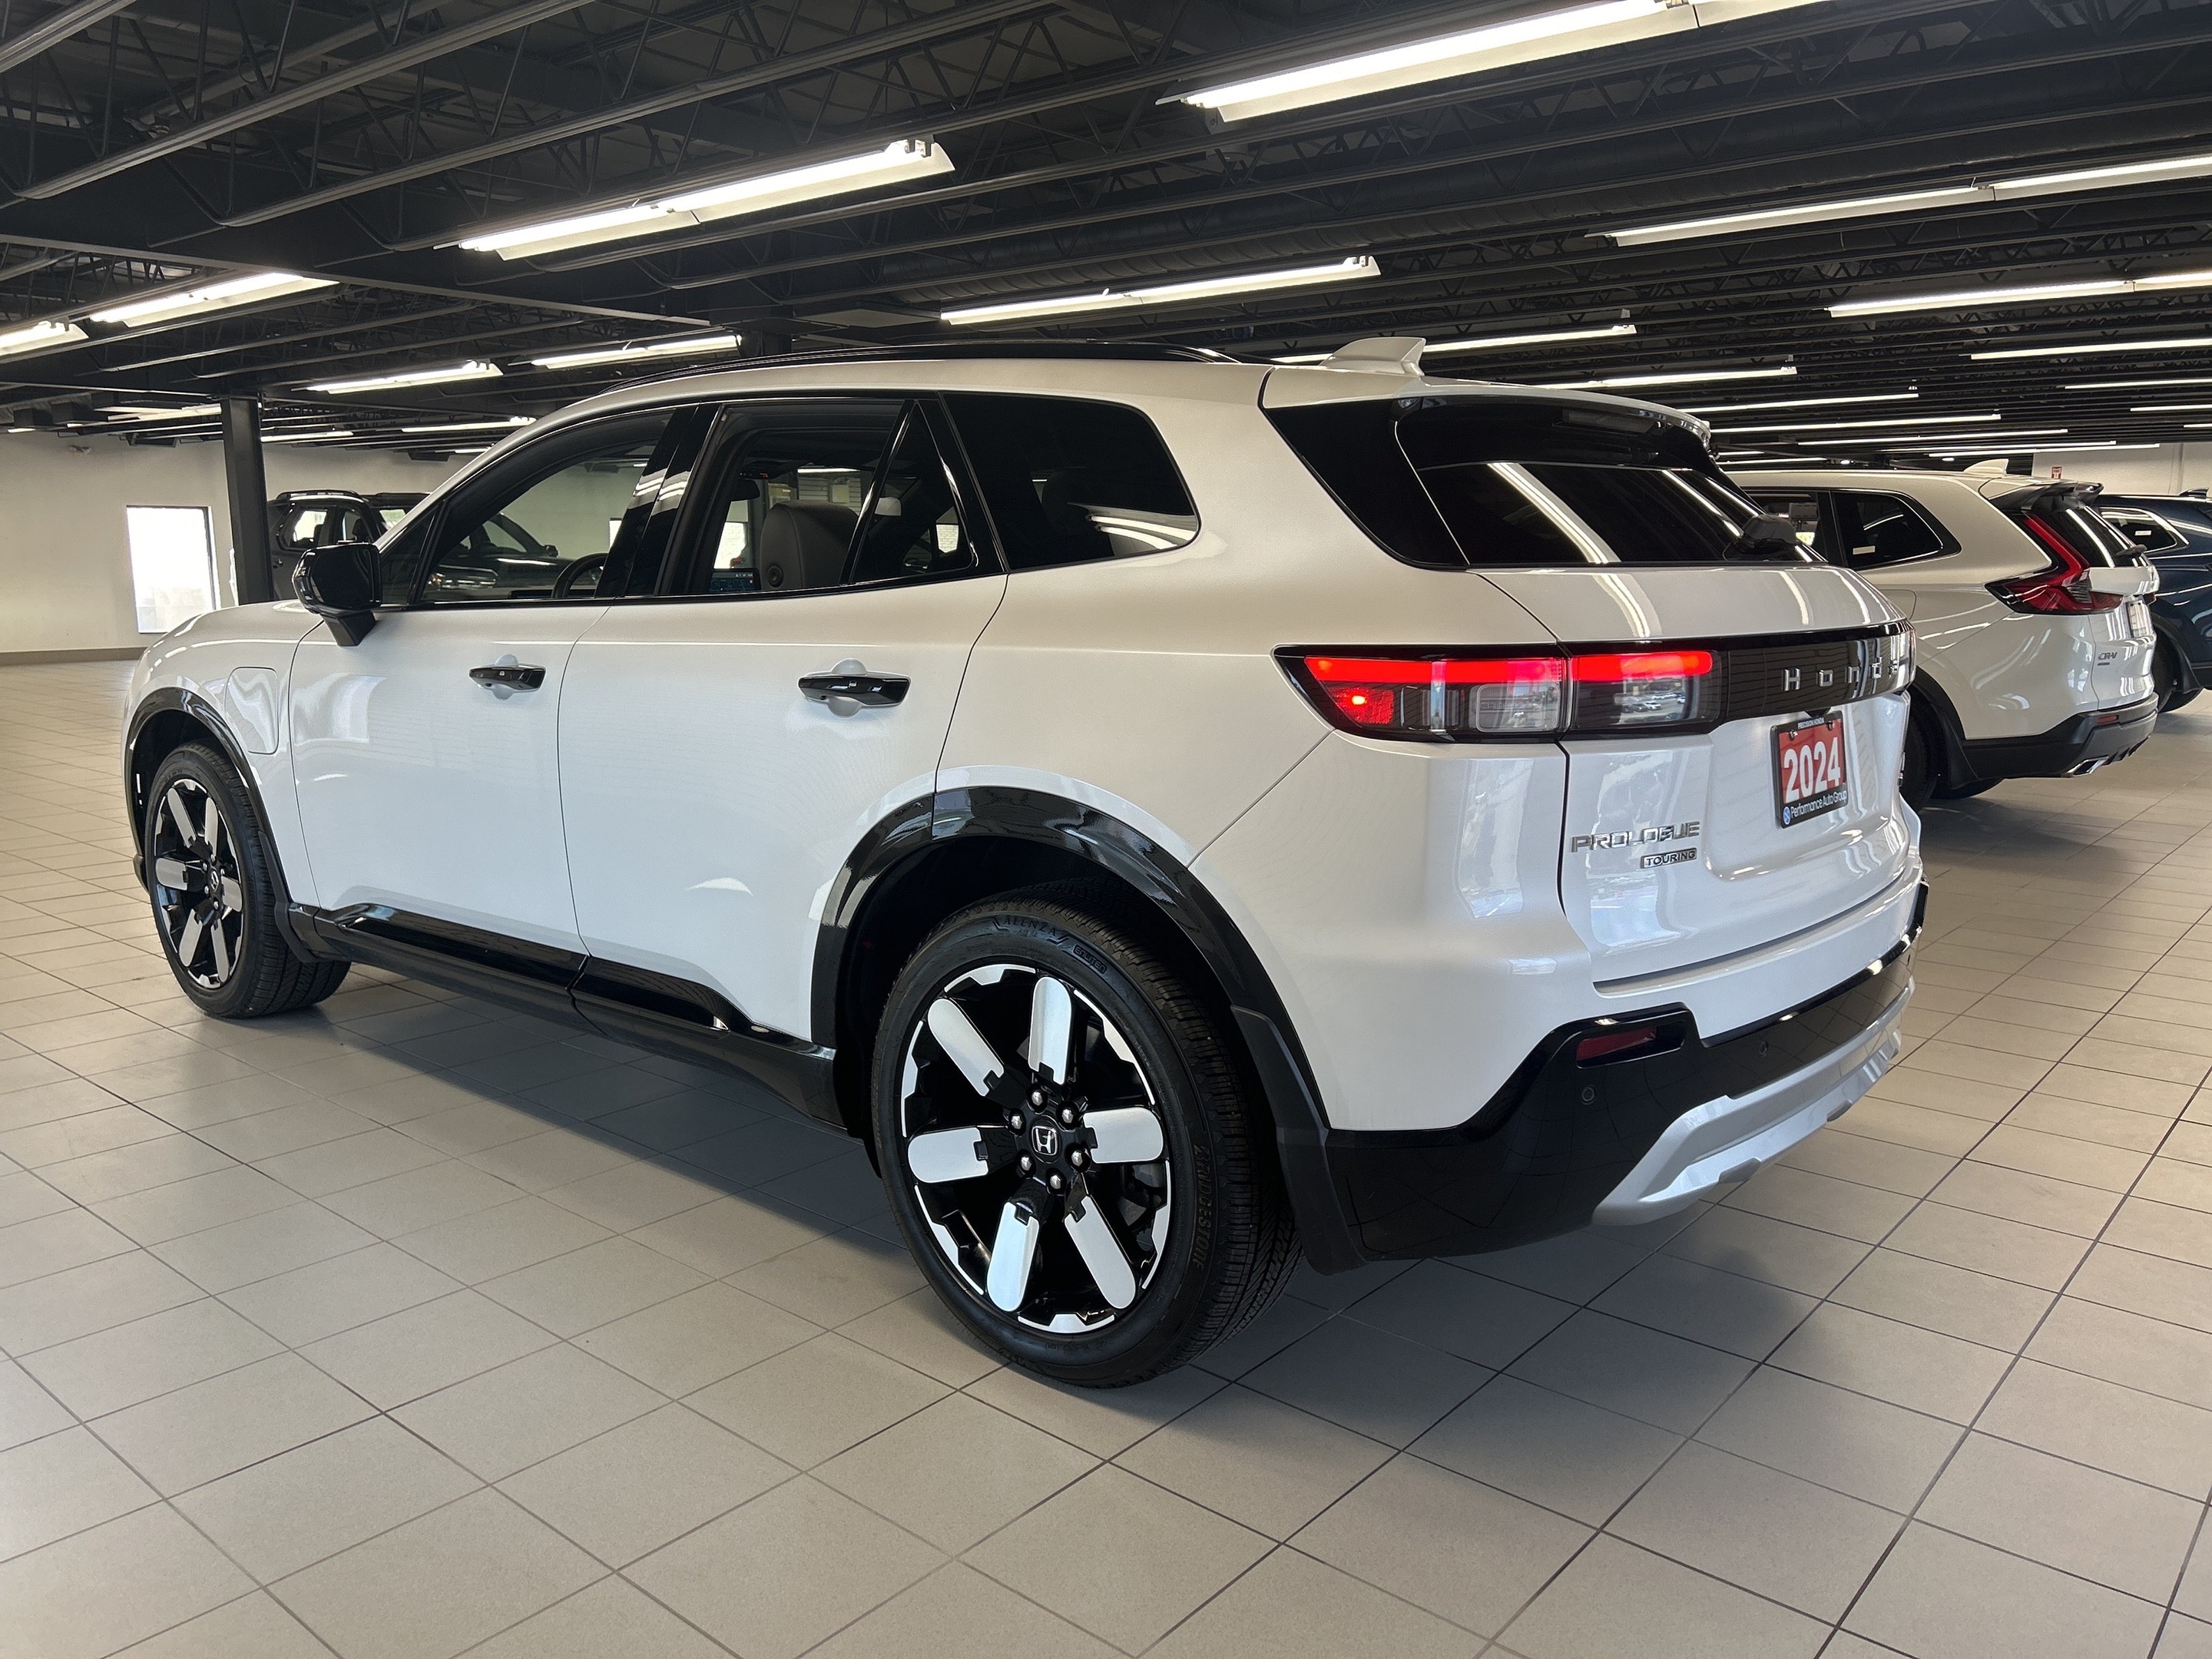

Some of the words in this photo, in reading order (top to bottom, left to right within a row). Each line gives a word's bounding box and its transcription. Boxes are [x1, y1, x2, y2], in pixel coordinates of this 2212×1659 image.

[2098, 651, 2118, 660] CR-V
[1783, 737, 1841, 804] 2024
[1790, 799, 1823, 818] Performance
[1823, 793, 1833, 807] Auto
[1833, 790, 1847, 803] Group
[1571, 821, 1700, 853] PROLOGUE
[1646, 850, 1696, 866] TOURING
[1003, 915, 1057, 936] ALENZA
[1194, 1144, 1211, 1271] BRIDGESTONE
